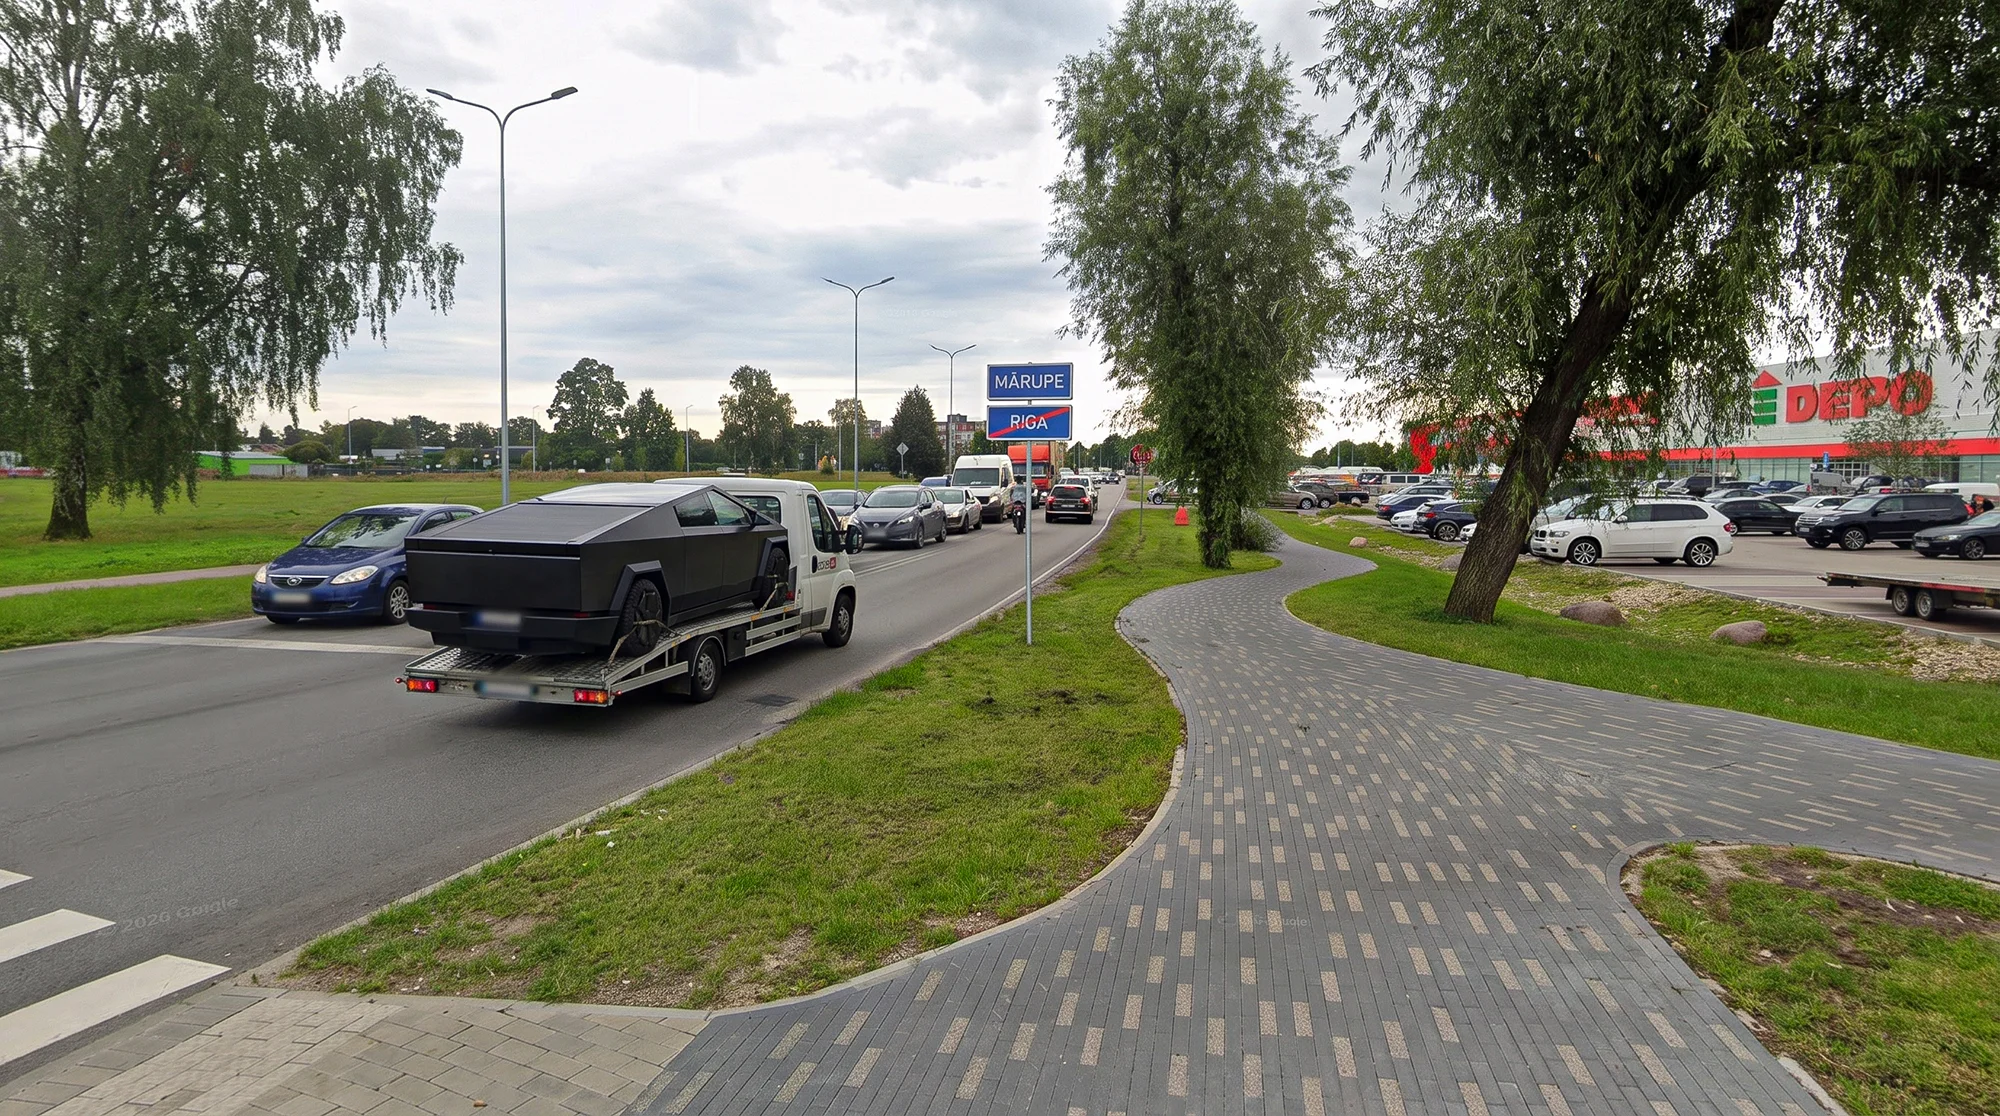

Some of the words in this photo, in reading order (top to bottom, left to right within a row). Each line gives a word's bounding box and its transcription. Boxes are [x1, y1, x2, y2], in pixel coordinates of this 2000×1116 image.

[994, 372, 1065, 389] MĀRUPE
[1785, 369, 1934, 424] DEPO
[1010, 414, 1048, 430] RIGA
